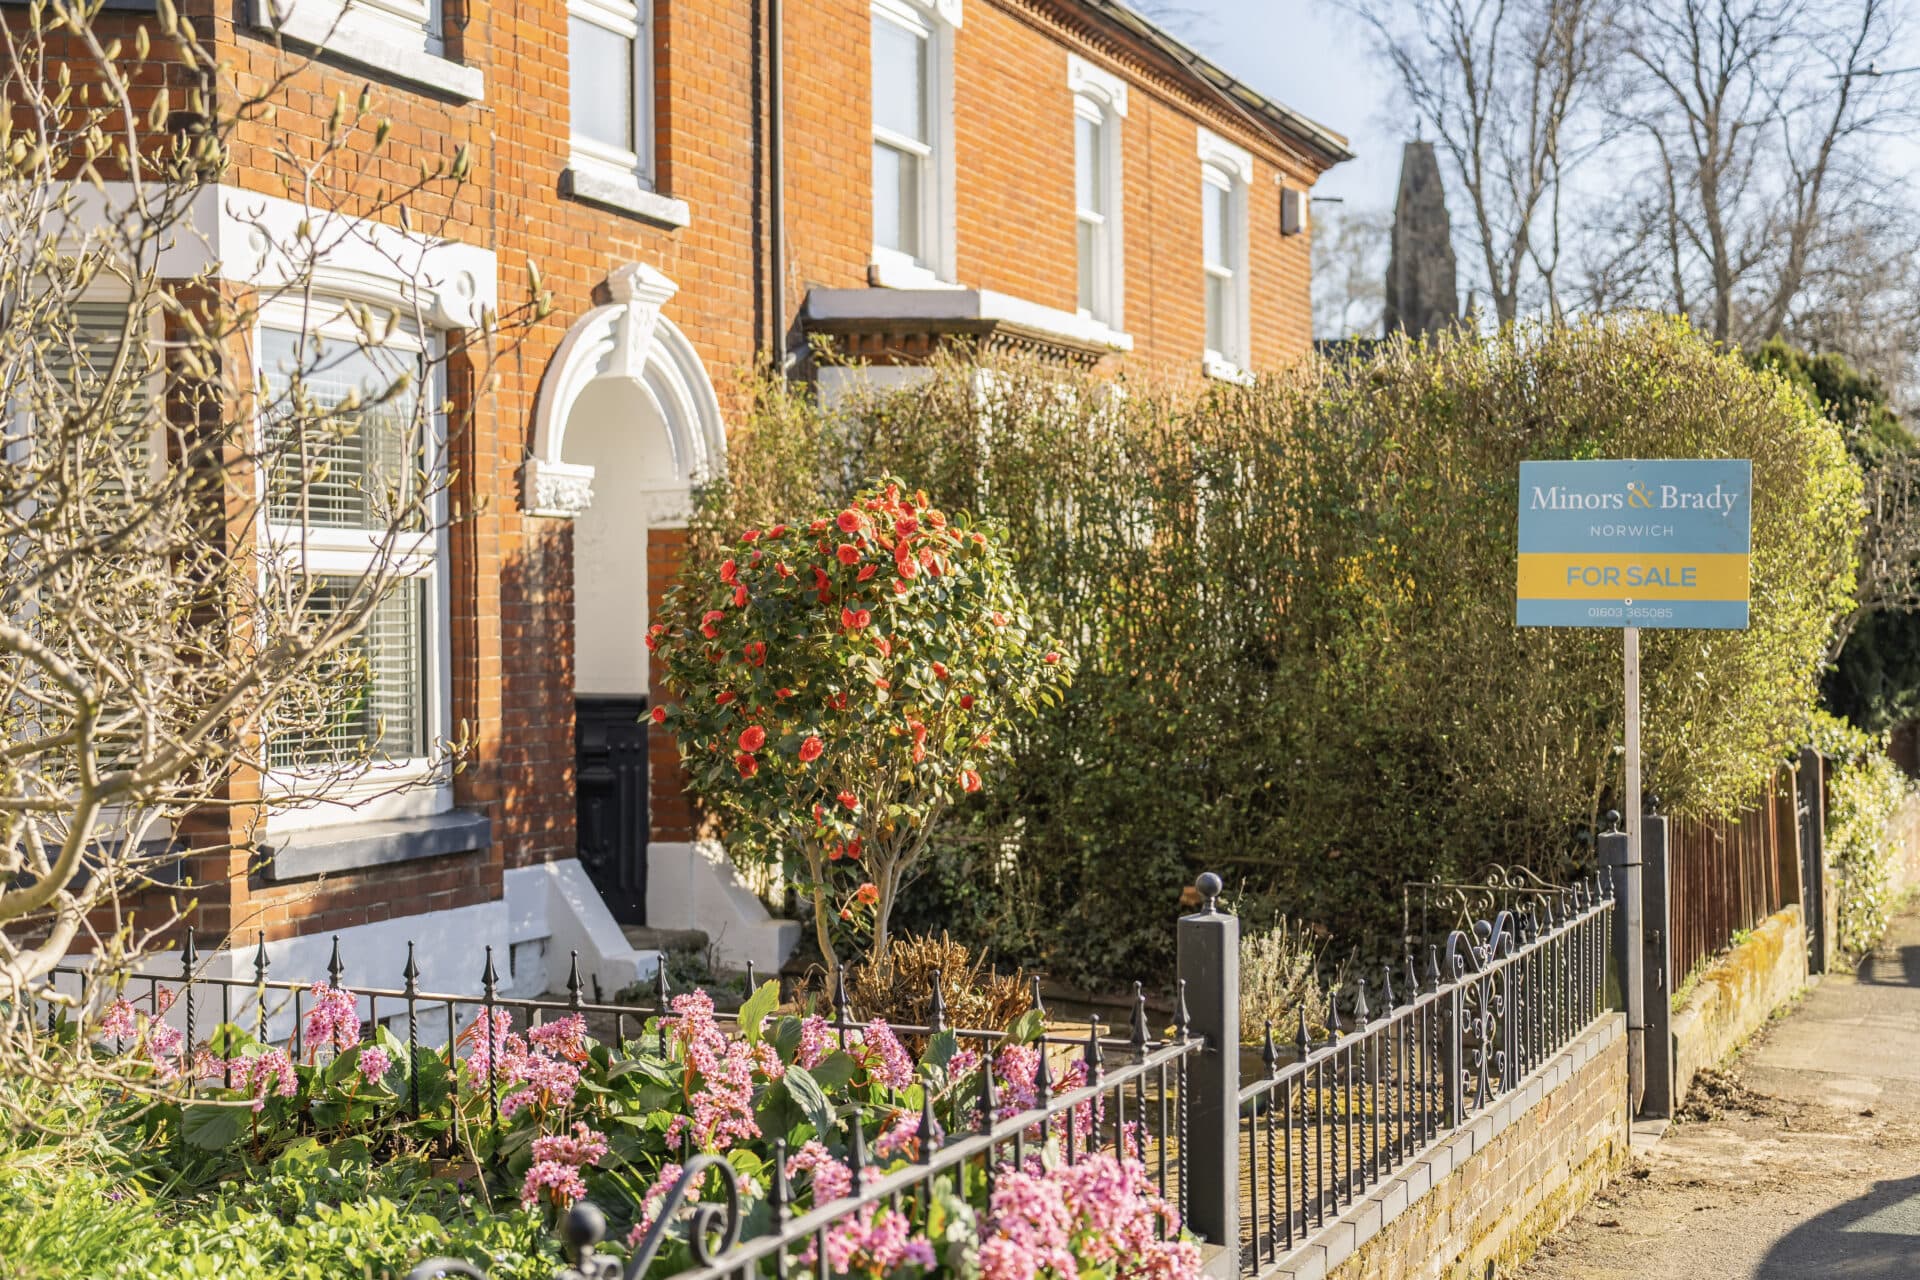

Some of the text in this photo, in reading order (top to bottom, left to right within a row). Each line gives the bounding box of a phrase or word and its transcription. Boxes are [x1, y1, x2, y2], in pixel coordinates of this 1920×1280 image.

[1531, 480, 1739, 517] Minors & Brady
[1590, 524, 1674, 537] NORWICH
[1566, 566, 1697, 587] FOR SALE
[1588, 607, 1673, 618] 01603 365085
